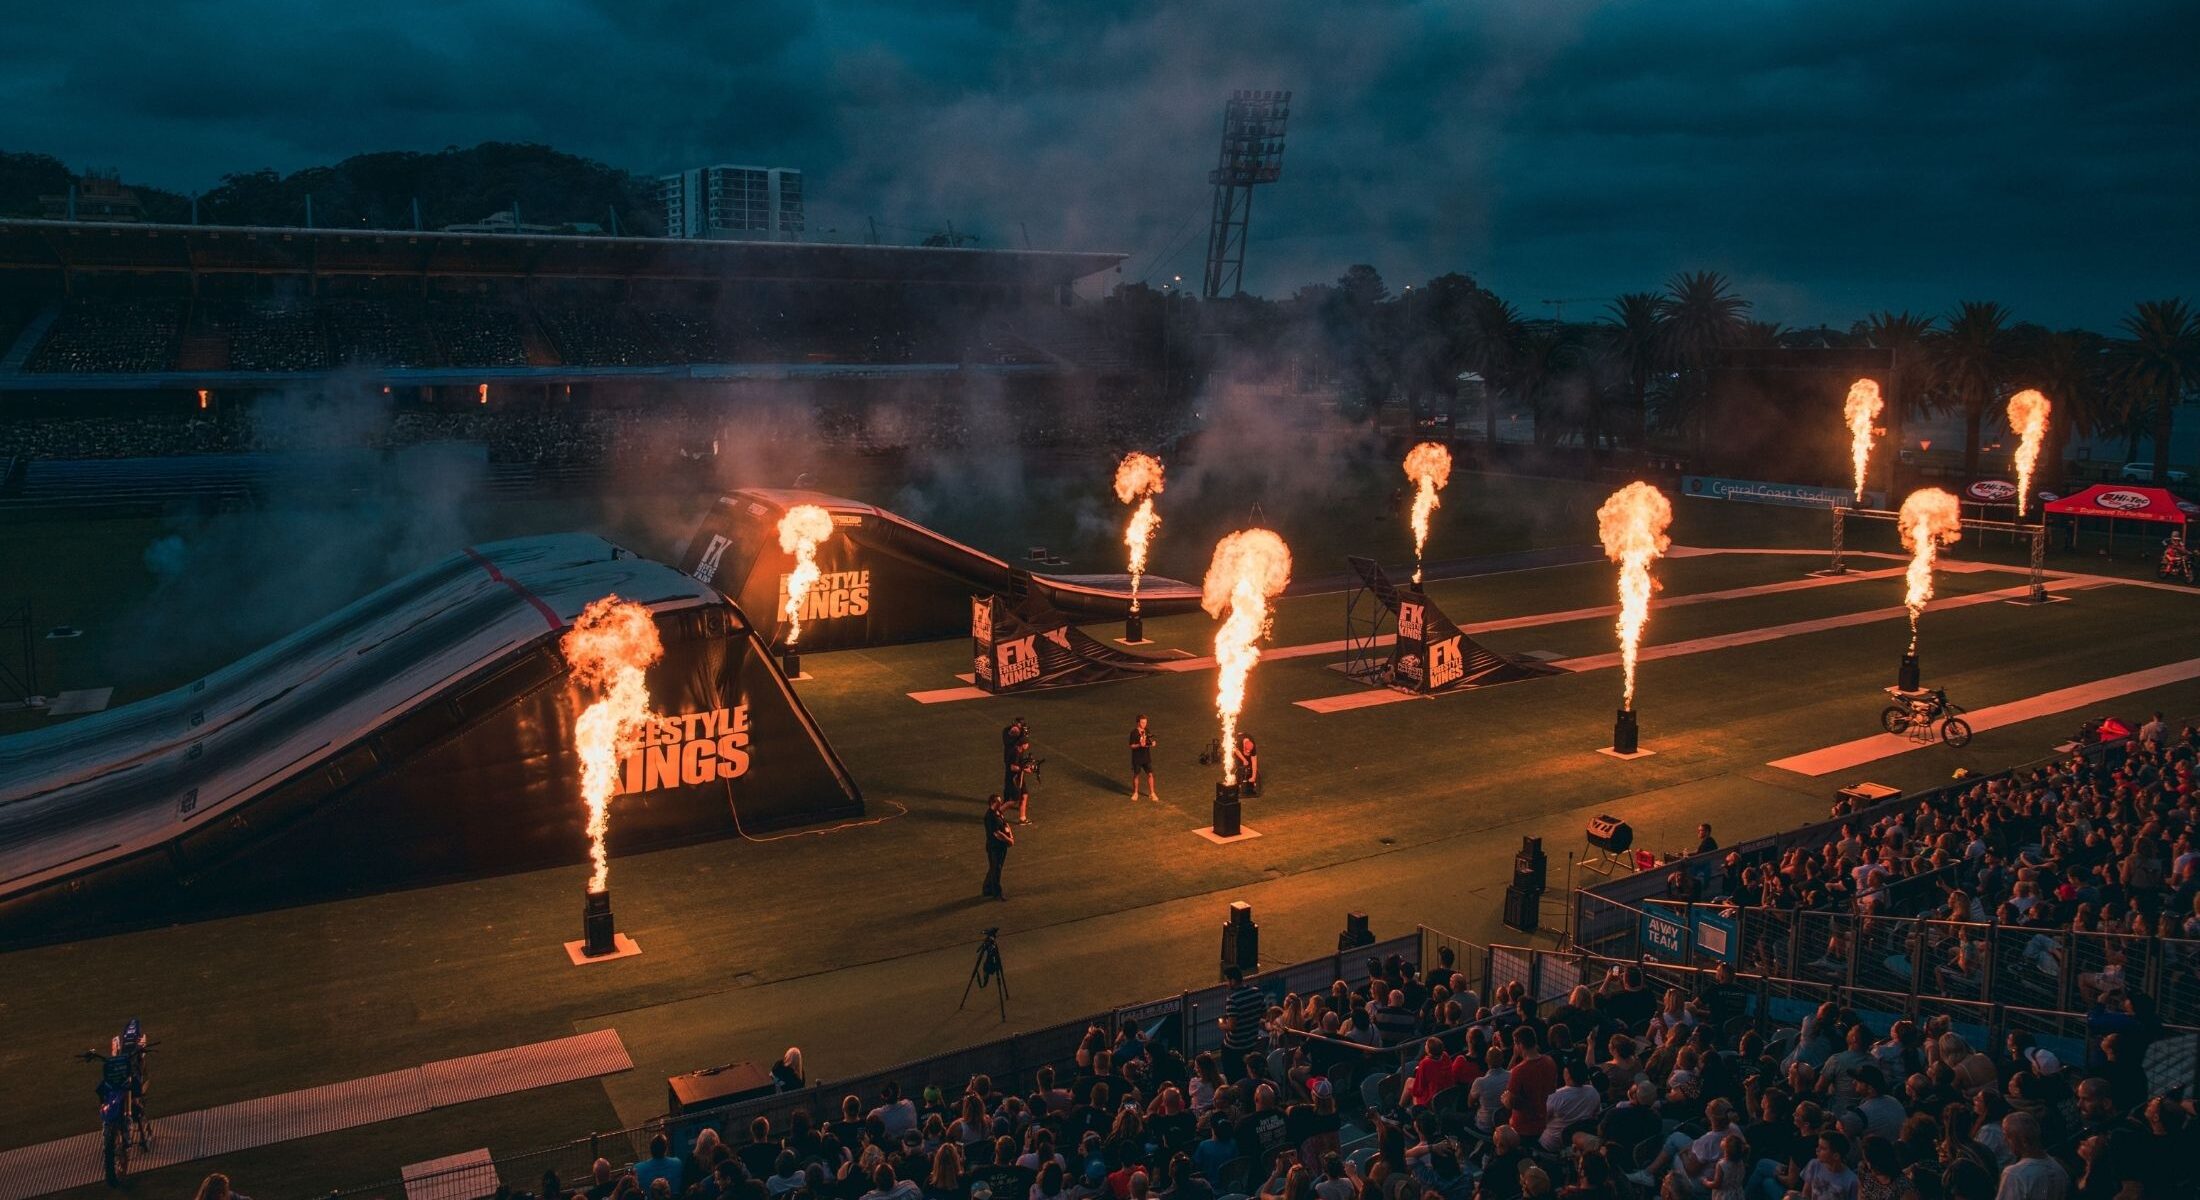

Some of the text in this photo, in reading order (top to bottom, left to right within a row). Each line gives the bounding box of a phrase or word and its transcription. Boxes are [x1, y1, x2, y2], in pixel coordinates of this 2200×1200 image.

[1712, 481, 1848, 506] Central Coast Stadium
[2112, 494, 2149, 504] Hi-Tec
[1400, 601, 1425, 624] FK
[1398, 625, 1422, 641] KINGS
[997, 634, 1038, 666] FK
[1429, 635, 1462, 668] FK
[1000, 665, 1041, 688] KINGS
[1430, 666, 1464, 689] KINGS
